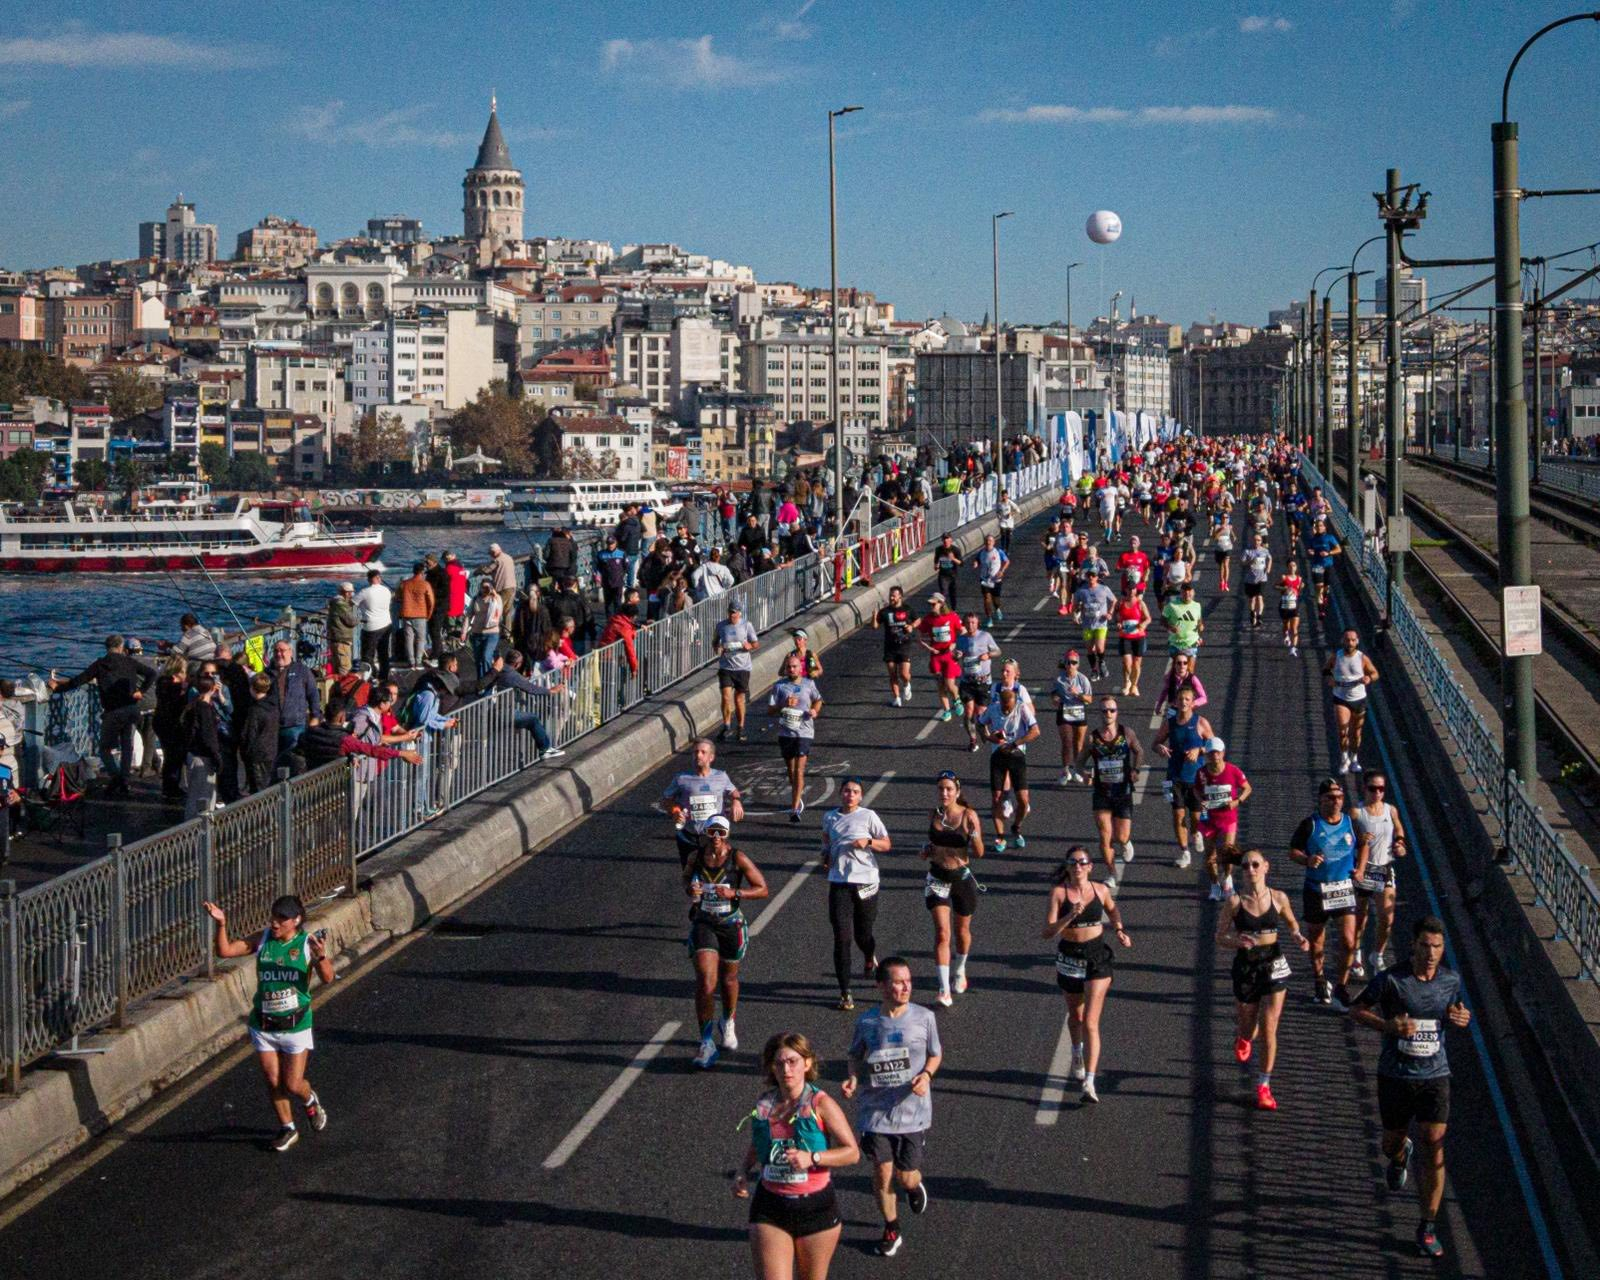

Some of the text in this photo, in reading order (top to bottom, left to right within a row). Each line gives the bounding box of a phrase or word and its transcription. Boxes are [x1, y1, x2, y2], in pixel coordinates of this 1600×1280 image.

[259, 970, 299, 981] BOLIVIA
[1412, 1031, 1439, 1041] 10339
[873, 1060, 905, 1072] D 4122
